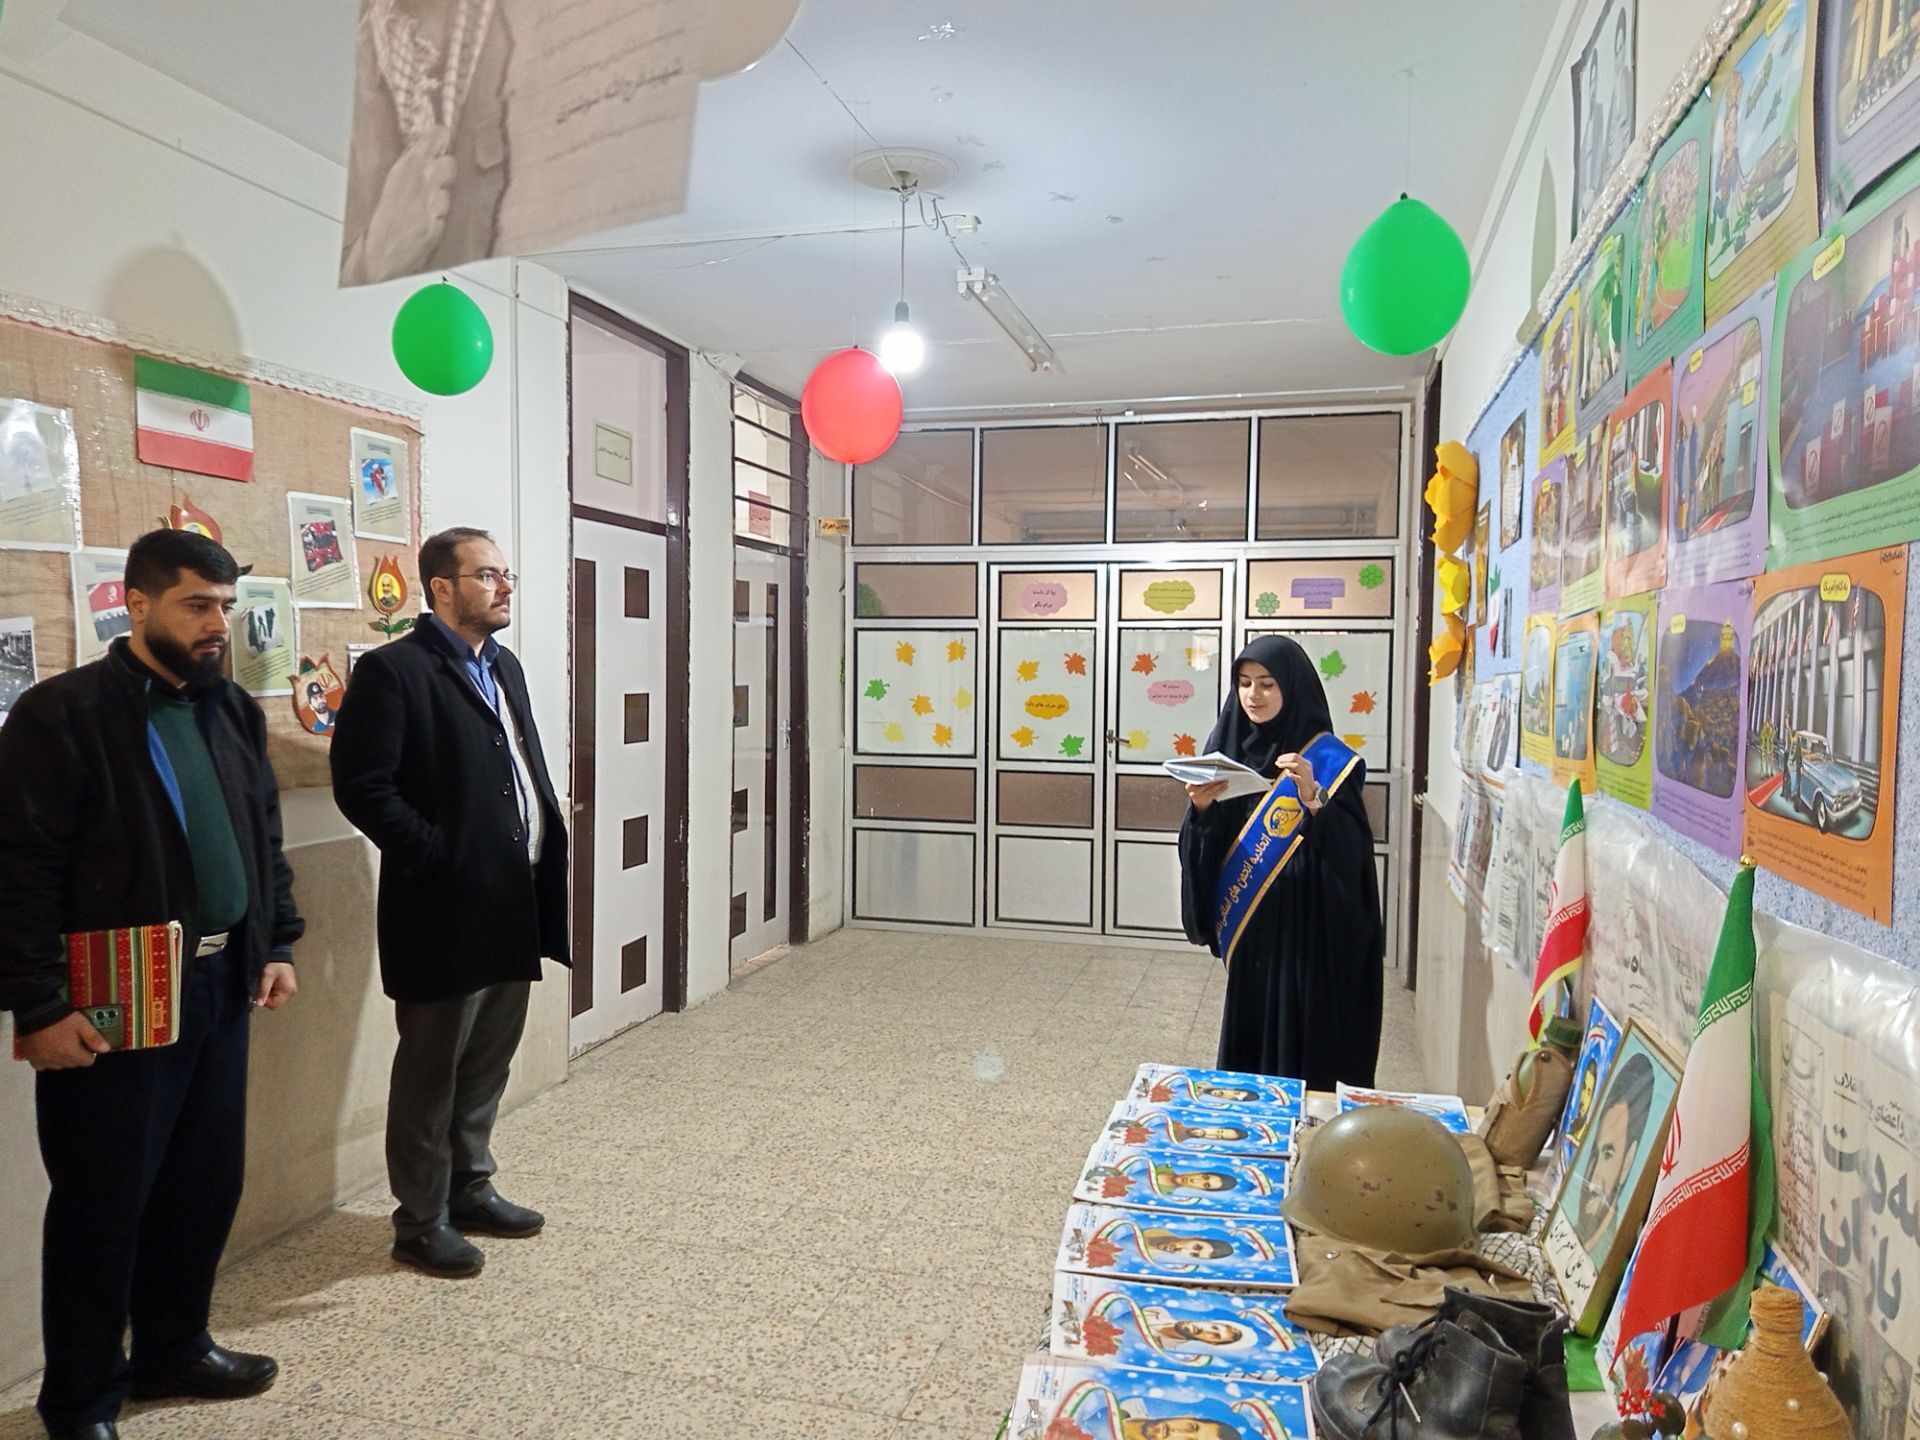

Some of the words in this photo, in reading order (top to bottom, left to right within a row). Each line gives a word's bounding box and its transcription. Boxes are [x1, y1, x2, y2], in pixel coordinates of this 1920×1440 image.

[1249, 832, 1272, 865] اتحادیه
[1237, 860, 1254, 889] انجمن
[1229, 885, 1240, 904] های
